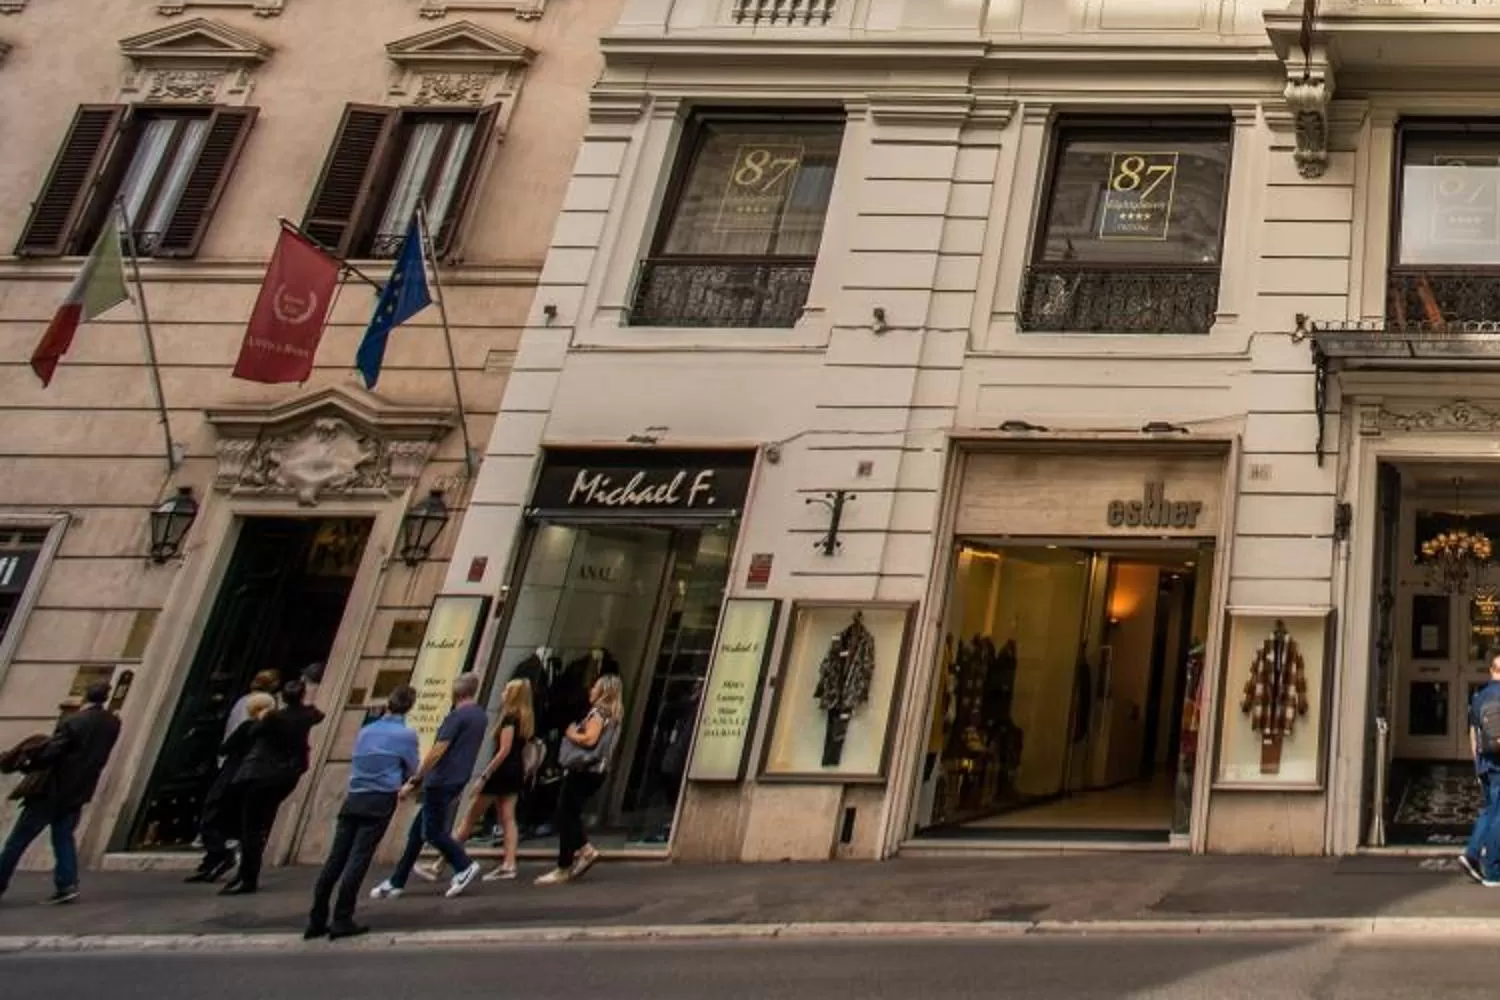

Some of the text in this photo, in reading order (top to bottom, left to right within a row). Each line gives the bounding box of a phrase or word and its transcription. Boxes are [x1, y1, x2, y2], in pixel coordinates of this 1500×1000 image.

[735, 149, 798, 193] 87
[1113, 156, 1173, 200] 87
[568, 468, 716, 507] Michael F.
[1107, 481, 1203, 529] esther
